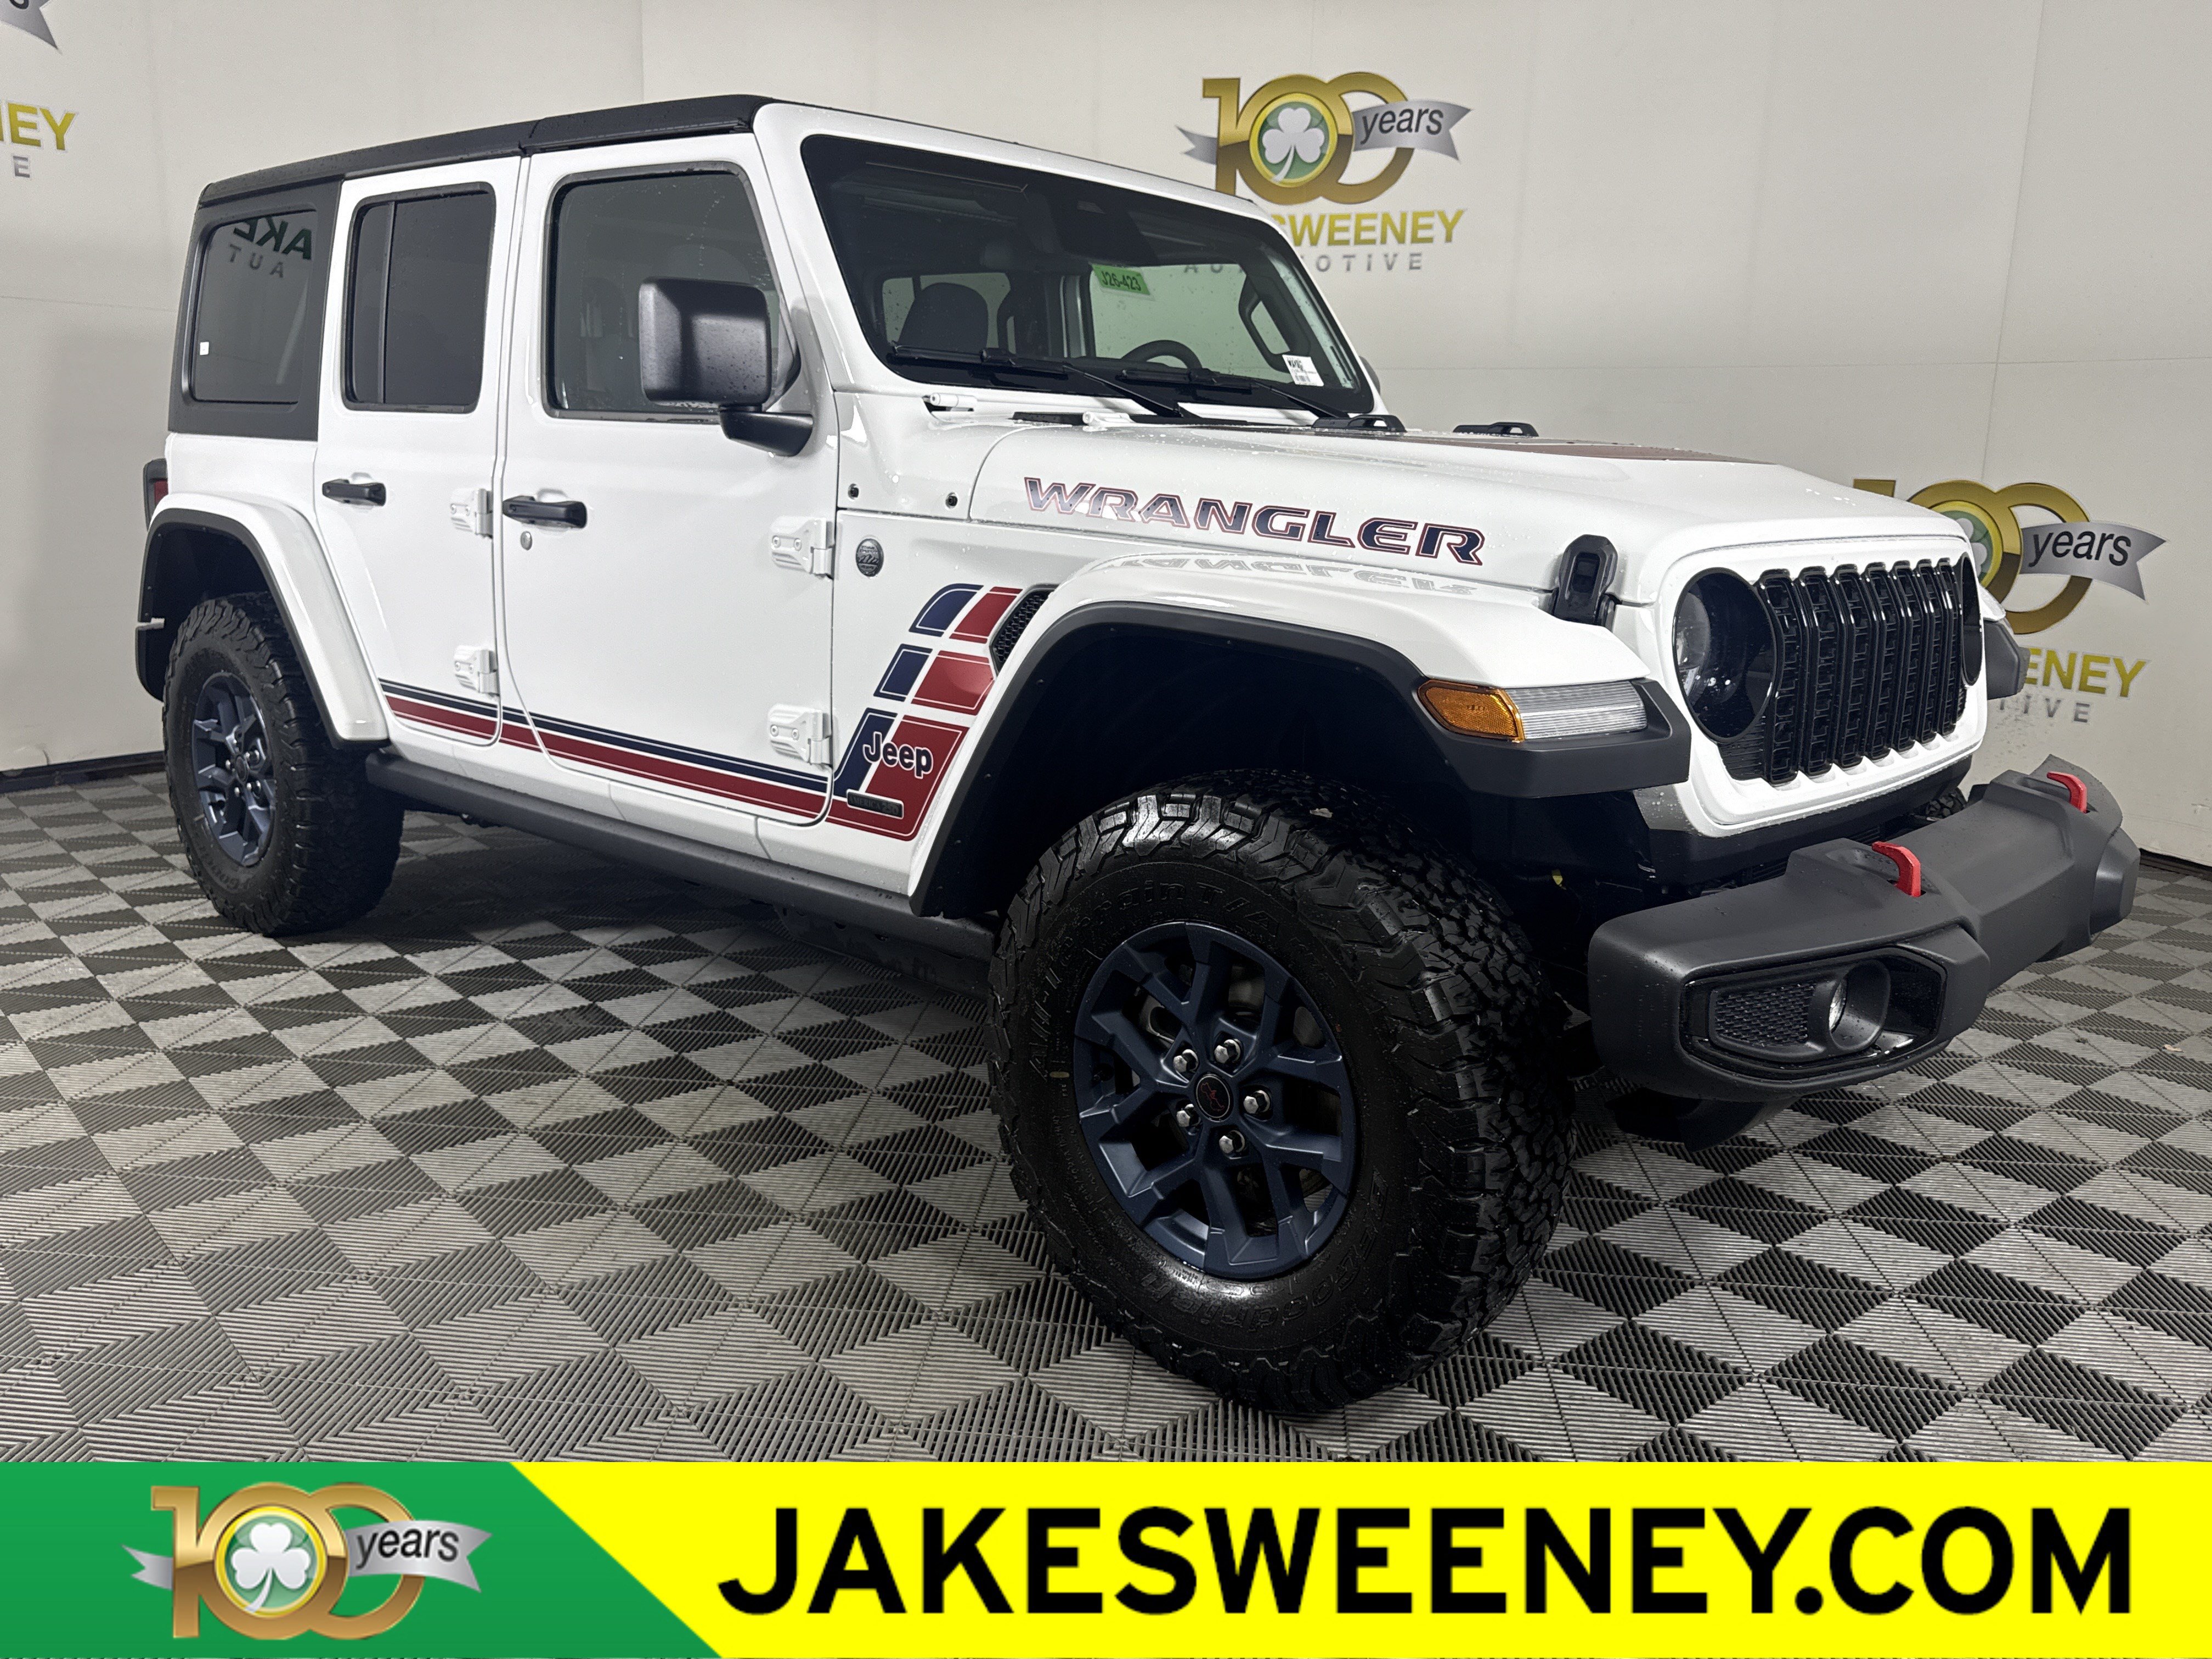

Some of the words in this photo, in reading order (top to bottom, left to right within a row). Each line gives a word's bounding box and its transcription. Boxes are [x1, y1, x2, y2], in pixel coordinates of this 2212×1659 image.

[1203, 72, 1415, 205] 100
[1361, 108, 1444, 144] years
[1024, 476, 1485, 566] WRANGLER
[2028, 530, 2131, 567] years
[863, 731, 934, 779] Jeep
